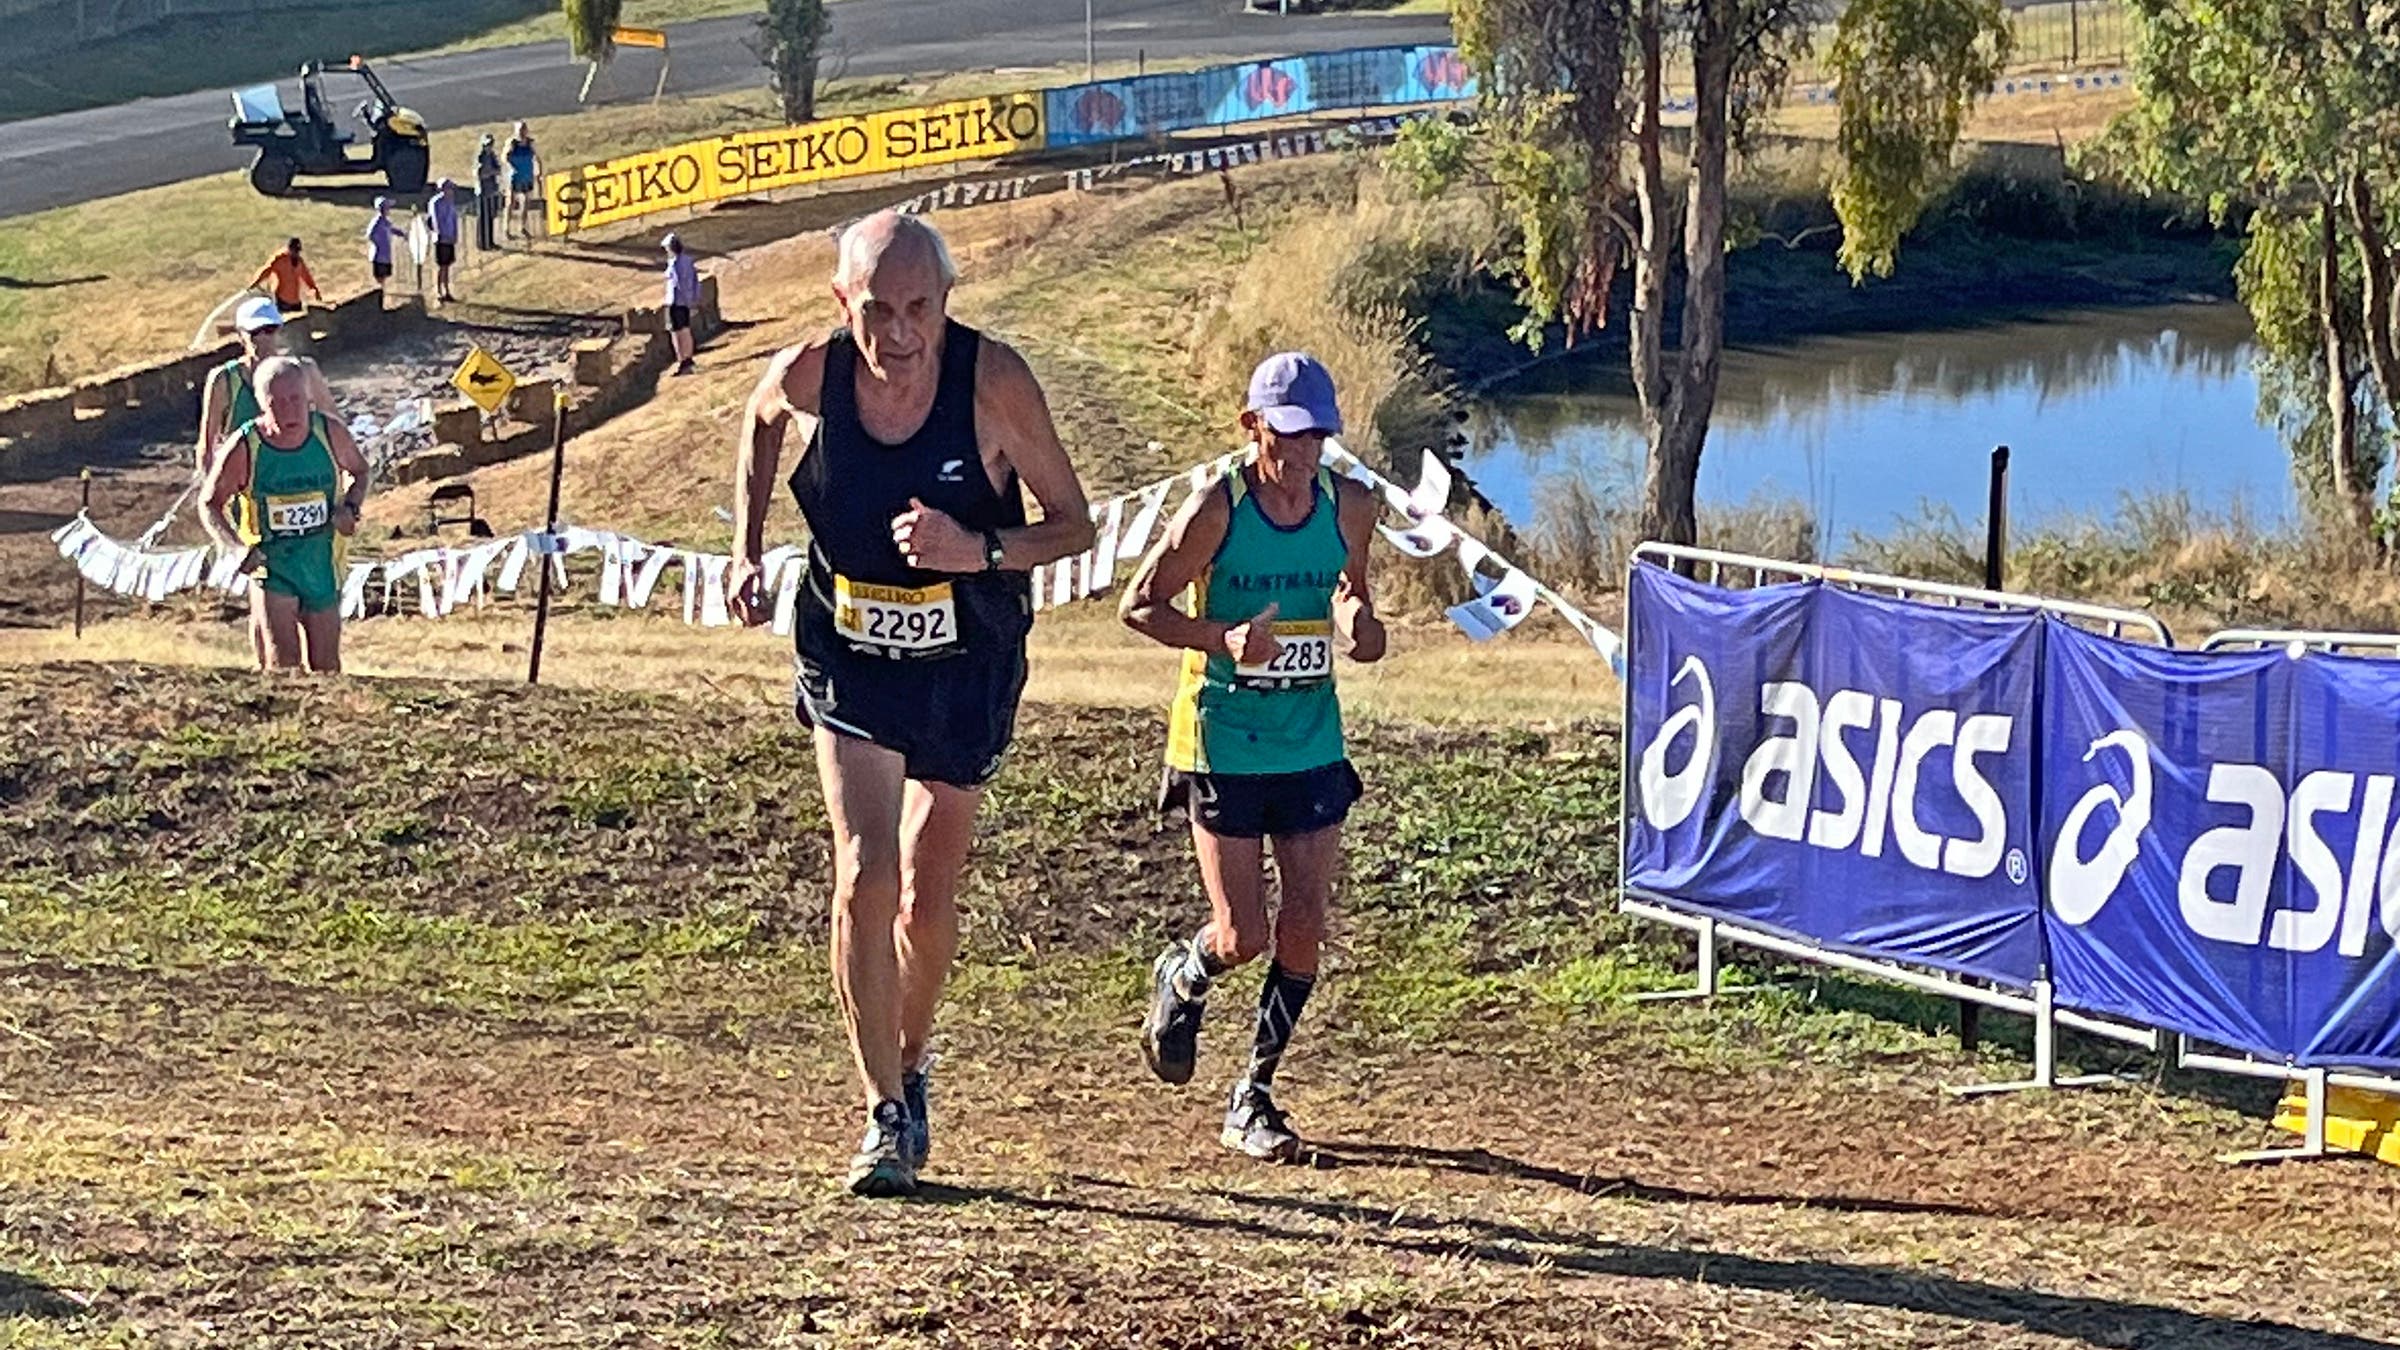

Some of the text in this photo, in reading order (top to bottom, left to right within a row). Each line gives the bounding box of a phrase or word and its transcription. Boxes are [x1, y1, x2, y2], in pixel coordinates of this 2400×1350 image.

[555, 100, 1040, 223] SEIKO SEIKO SEIKO
[286, 505, 325, 525] 2291
[1229, 570, 1339, 591] AUSTRALI
[867, 607, 947, 643] 2292
[1738, 682, 2013, 878] asics
[2177, 763, 2400, 958] asi
